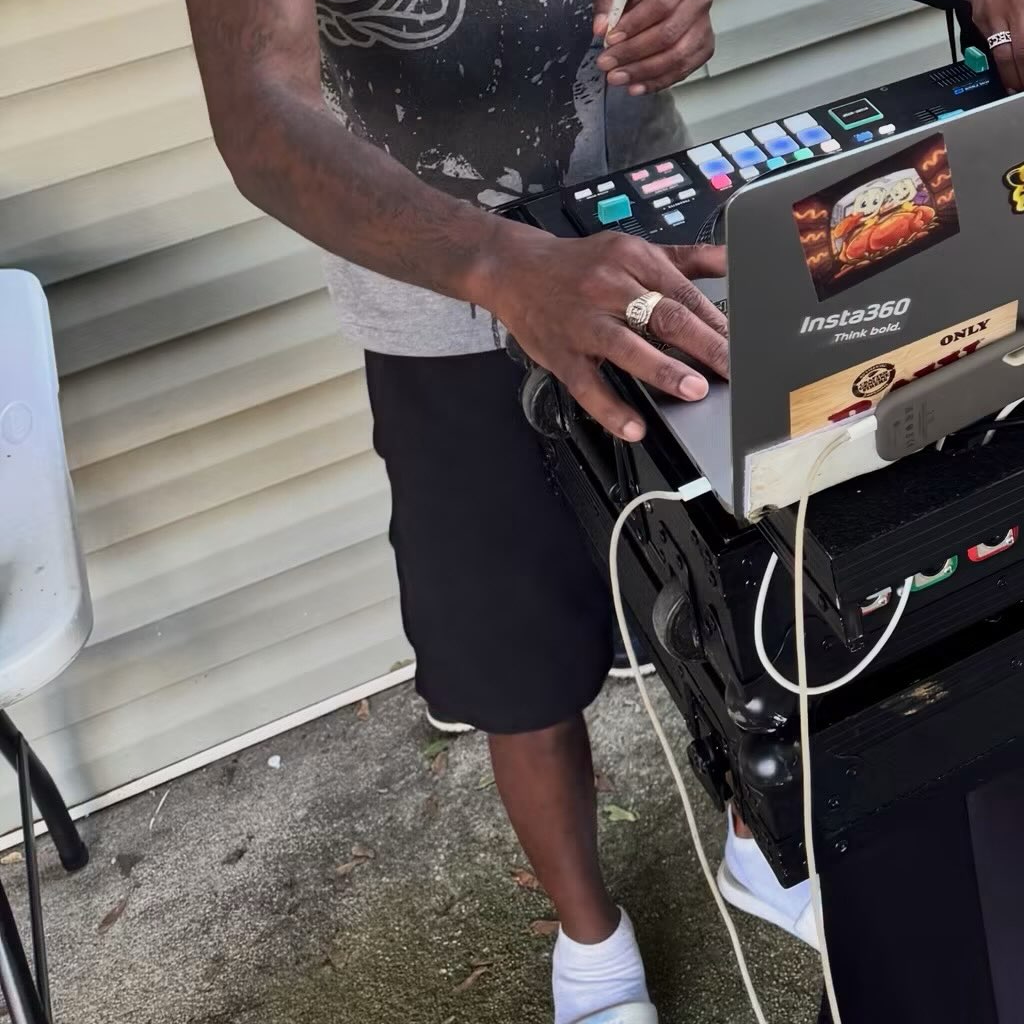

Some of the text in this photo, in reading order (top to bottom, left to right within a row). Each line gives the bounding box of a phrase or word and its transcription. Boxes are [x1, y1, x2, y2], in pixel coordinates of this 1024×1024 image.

[800, 297, 911, 334] Insta360
[834, 321, 901, 343] Think bold.
[940, 318, 991, 346] ONLY
